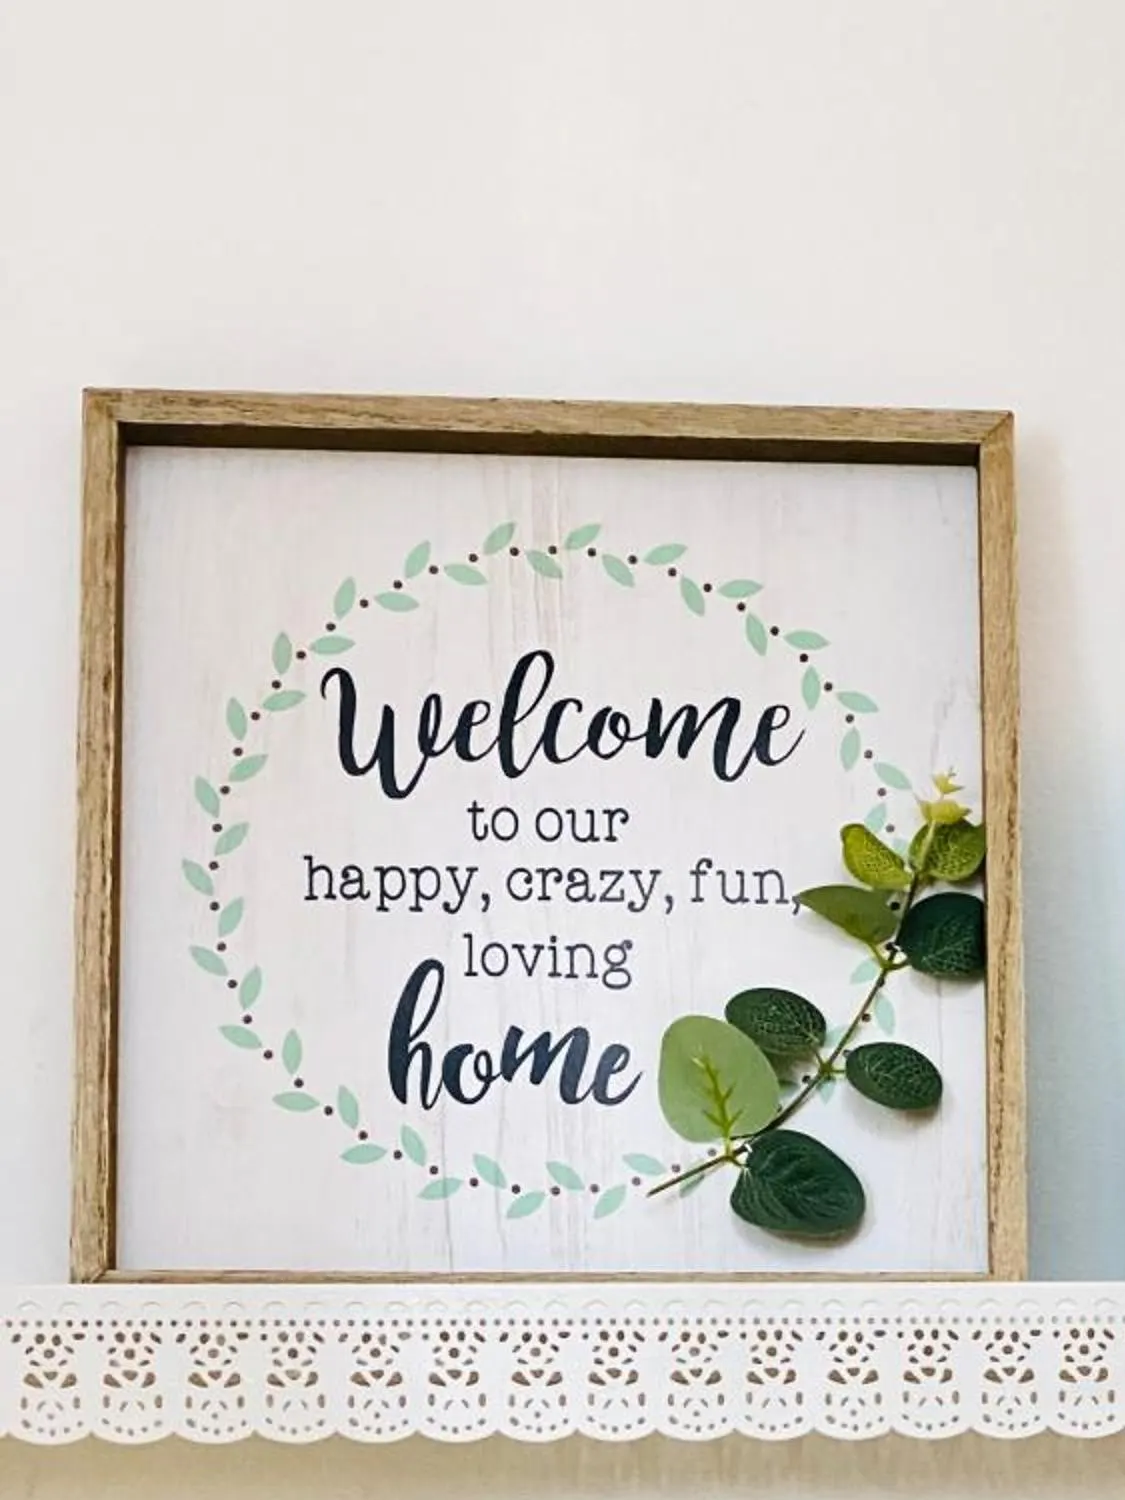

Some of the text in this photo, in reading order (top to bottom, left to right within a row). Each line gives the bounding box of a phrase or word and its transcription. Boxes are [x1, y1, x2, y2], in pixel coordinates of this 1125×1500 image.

[319, 649, 805, 799] Welcome
[467, 800, 630, 842] to our
[303, 855, 801, 915] happy, crazy, fun,
[462, 933, 634, 990] loving
[387, 957, 643, 1111] home
